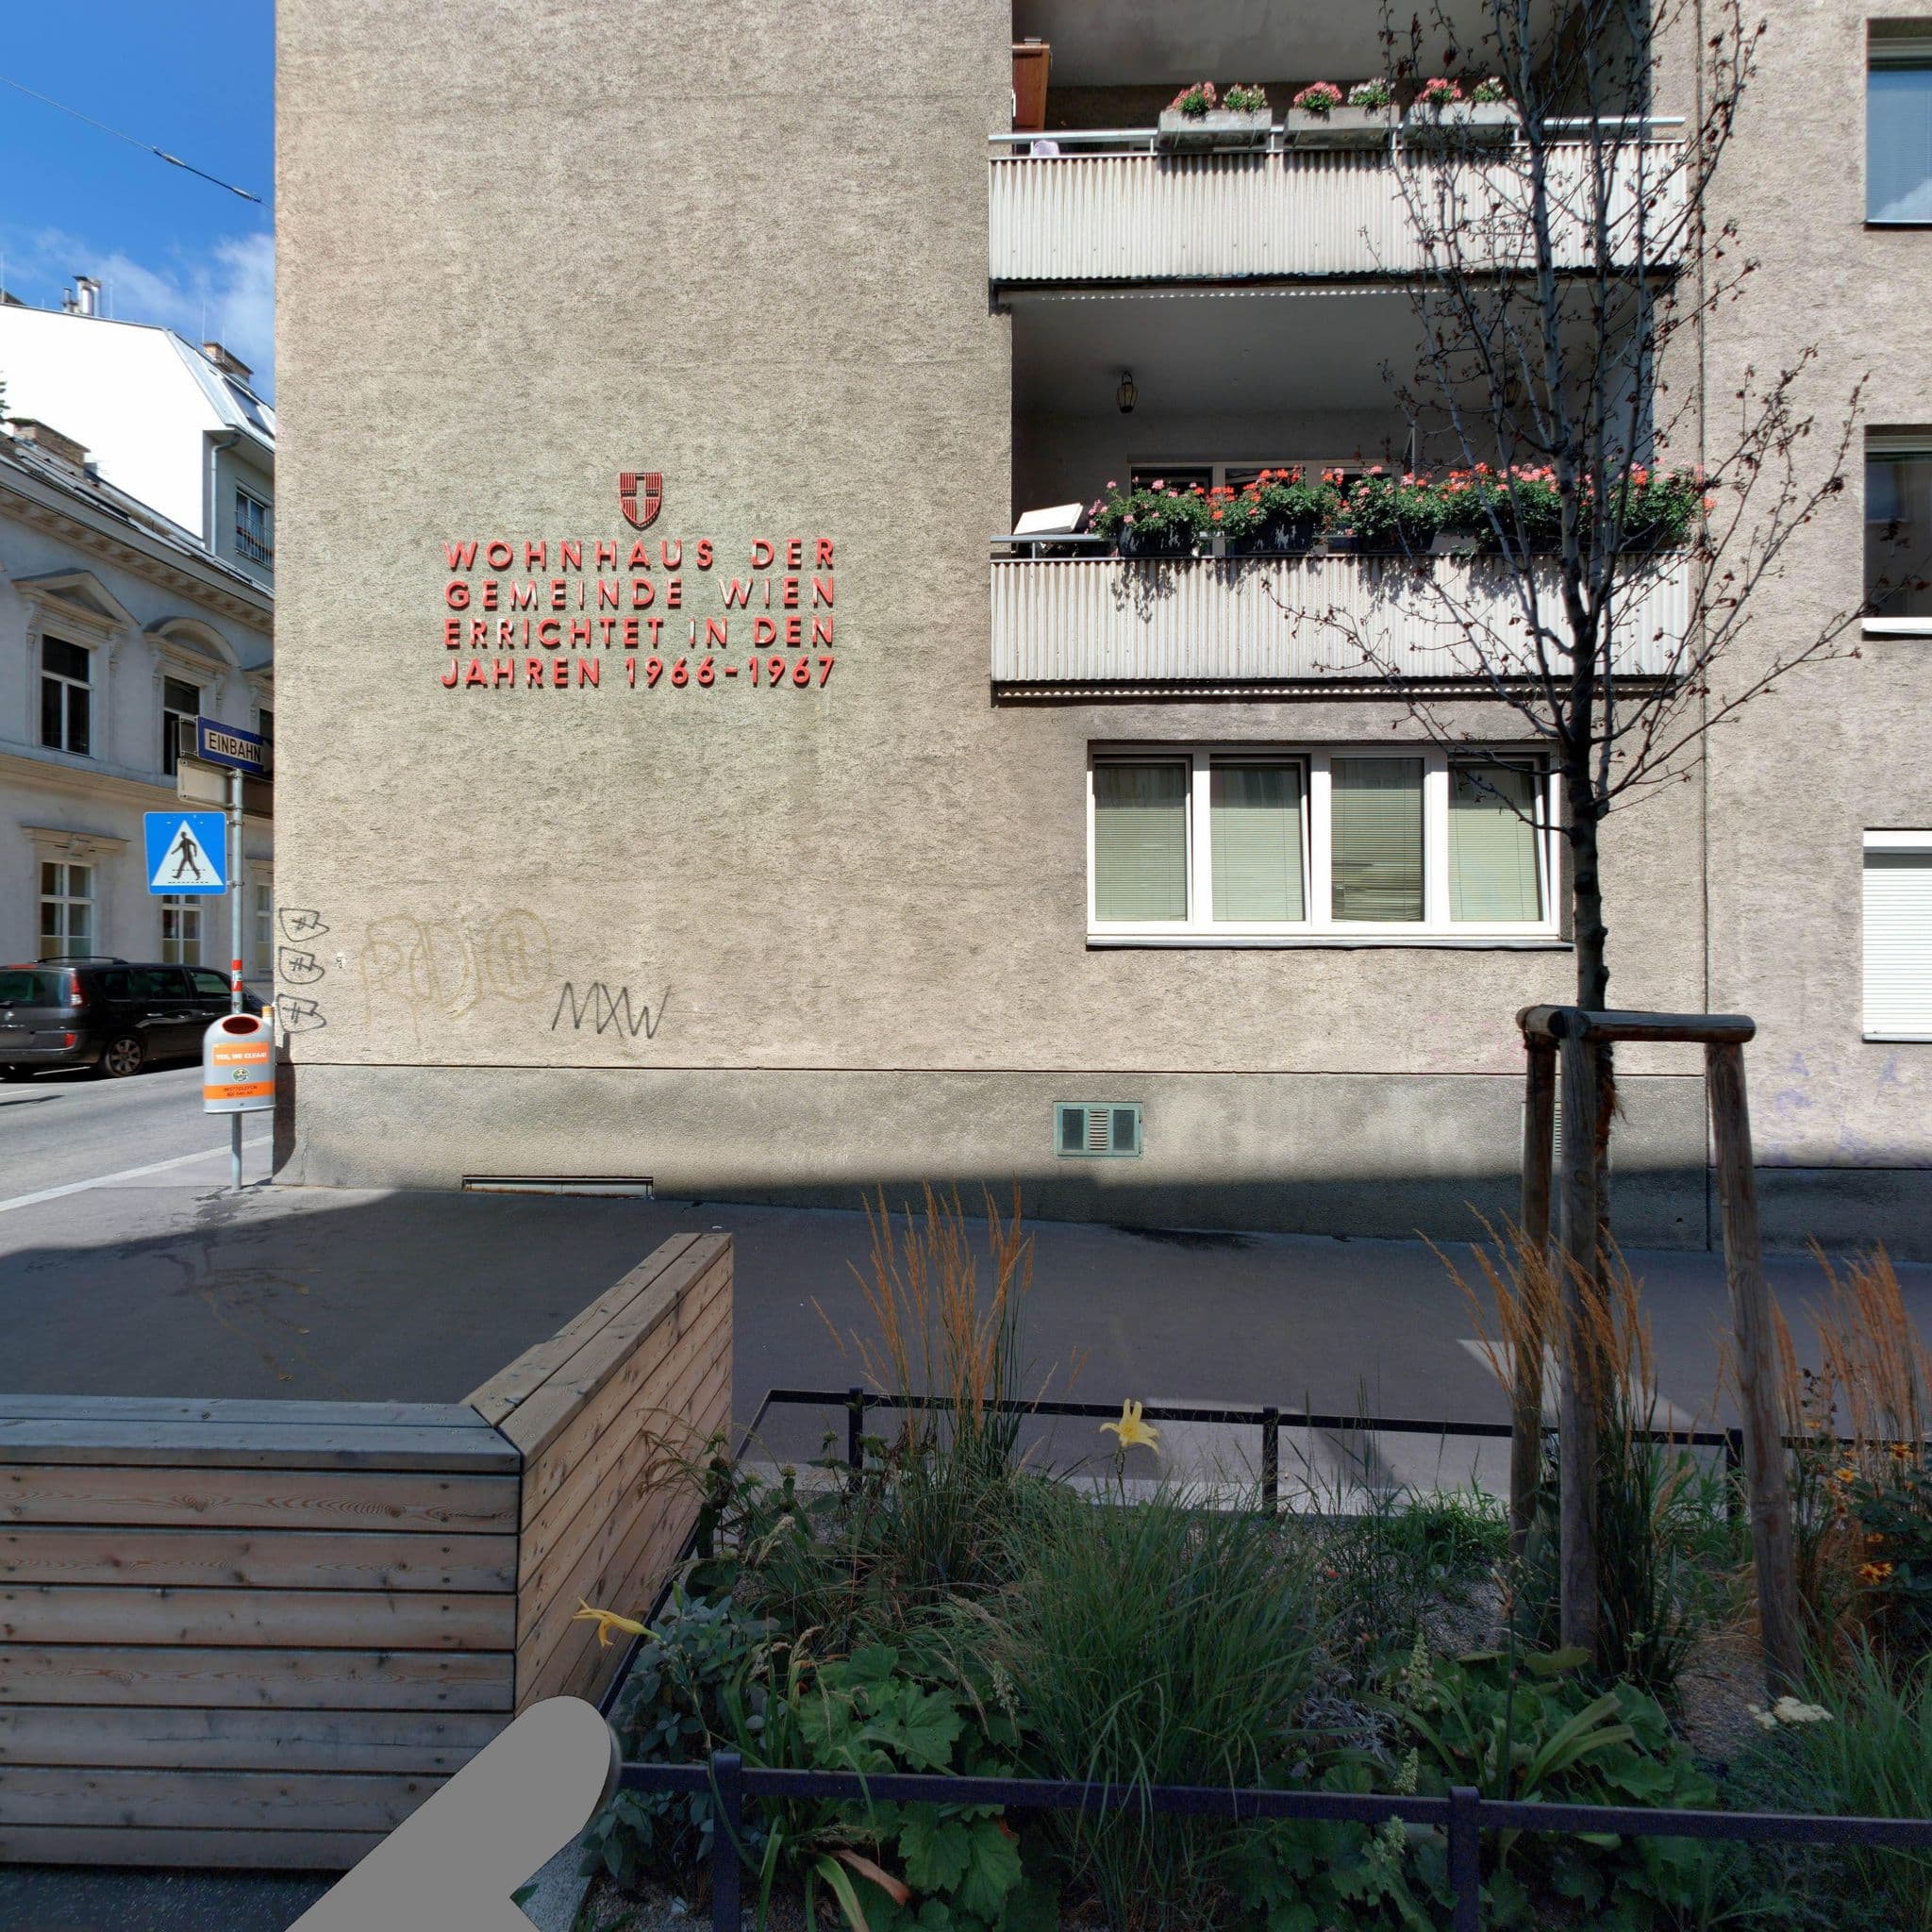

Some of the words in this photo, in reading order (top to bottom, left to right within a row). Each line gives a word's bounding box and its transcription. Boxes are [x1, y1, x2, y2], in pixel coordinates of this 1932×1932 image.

[443, 538, 713, 568] WOHNHAUS
[751, 538, 834, 568] DER
[444, 577, 681, 608] GEMEINDE
[719, 576, 834, 608] WIEN
[443, 617, 663, 647] ERRICHTET
[690, 617, 727, 648] IN
[754, 616, 834, 647] DEN
[441, 656, 600, 687] JAHREN
[625, 656, 835, 687] 1966-1967
[208, 731, 261, 762] EINBAHN
